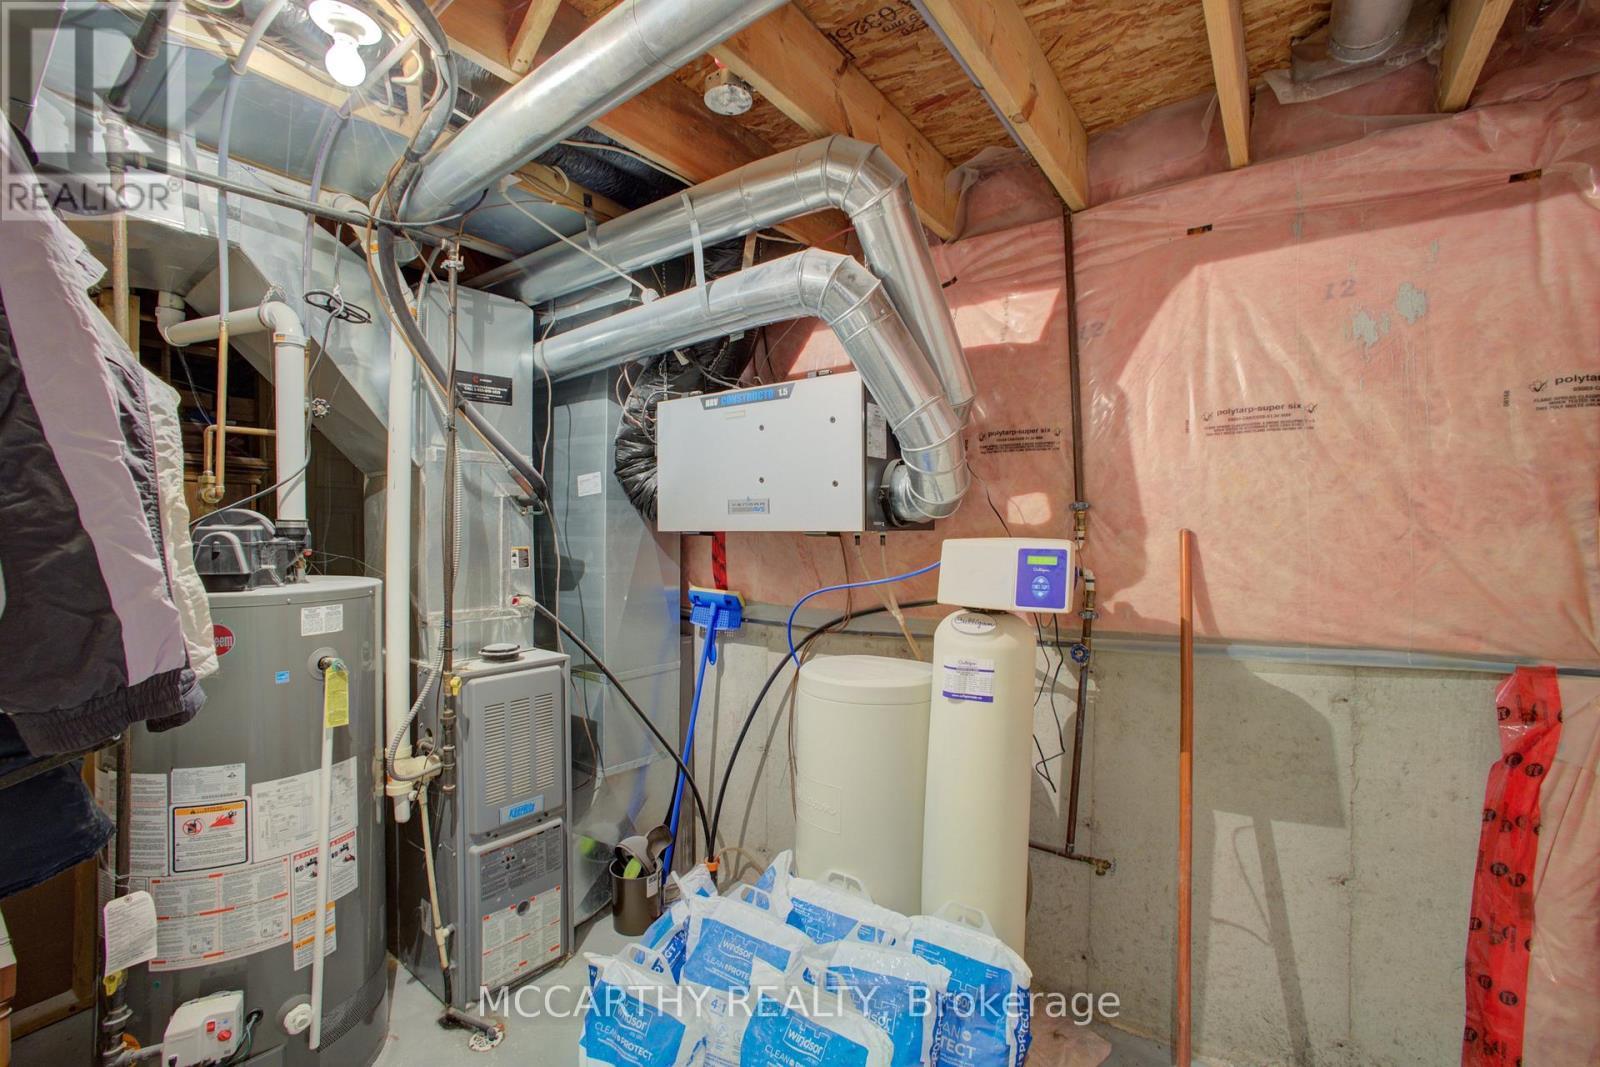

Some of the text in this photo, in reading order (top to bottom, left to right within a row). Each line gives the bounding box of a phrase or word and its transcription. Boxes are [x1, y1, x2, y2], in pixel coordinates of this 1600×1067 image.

[1555, 374, 1600, 386] polyta
[1288, 402, 1302, 410] six
[954, 616, 995, 628] Culligan
[214, 636, 233, 648] eem
[787, 1029, 824, 1056] windsor
[764, 1043, 791, 1064] CLEAN
